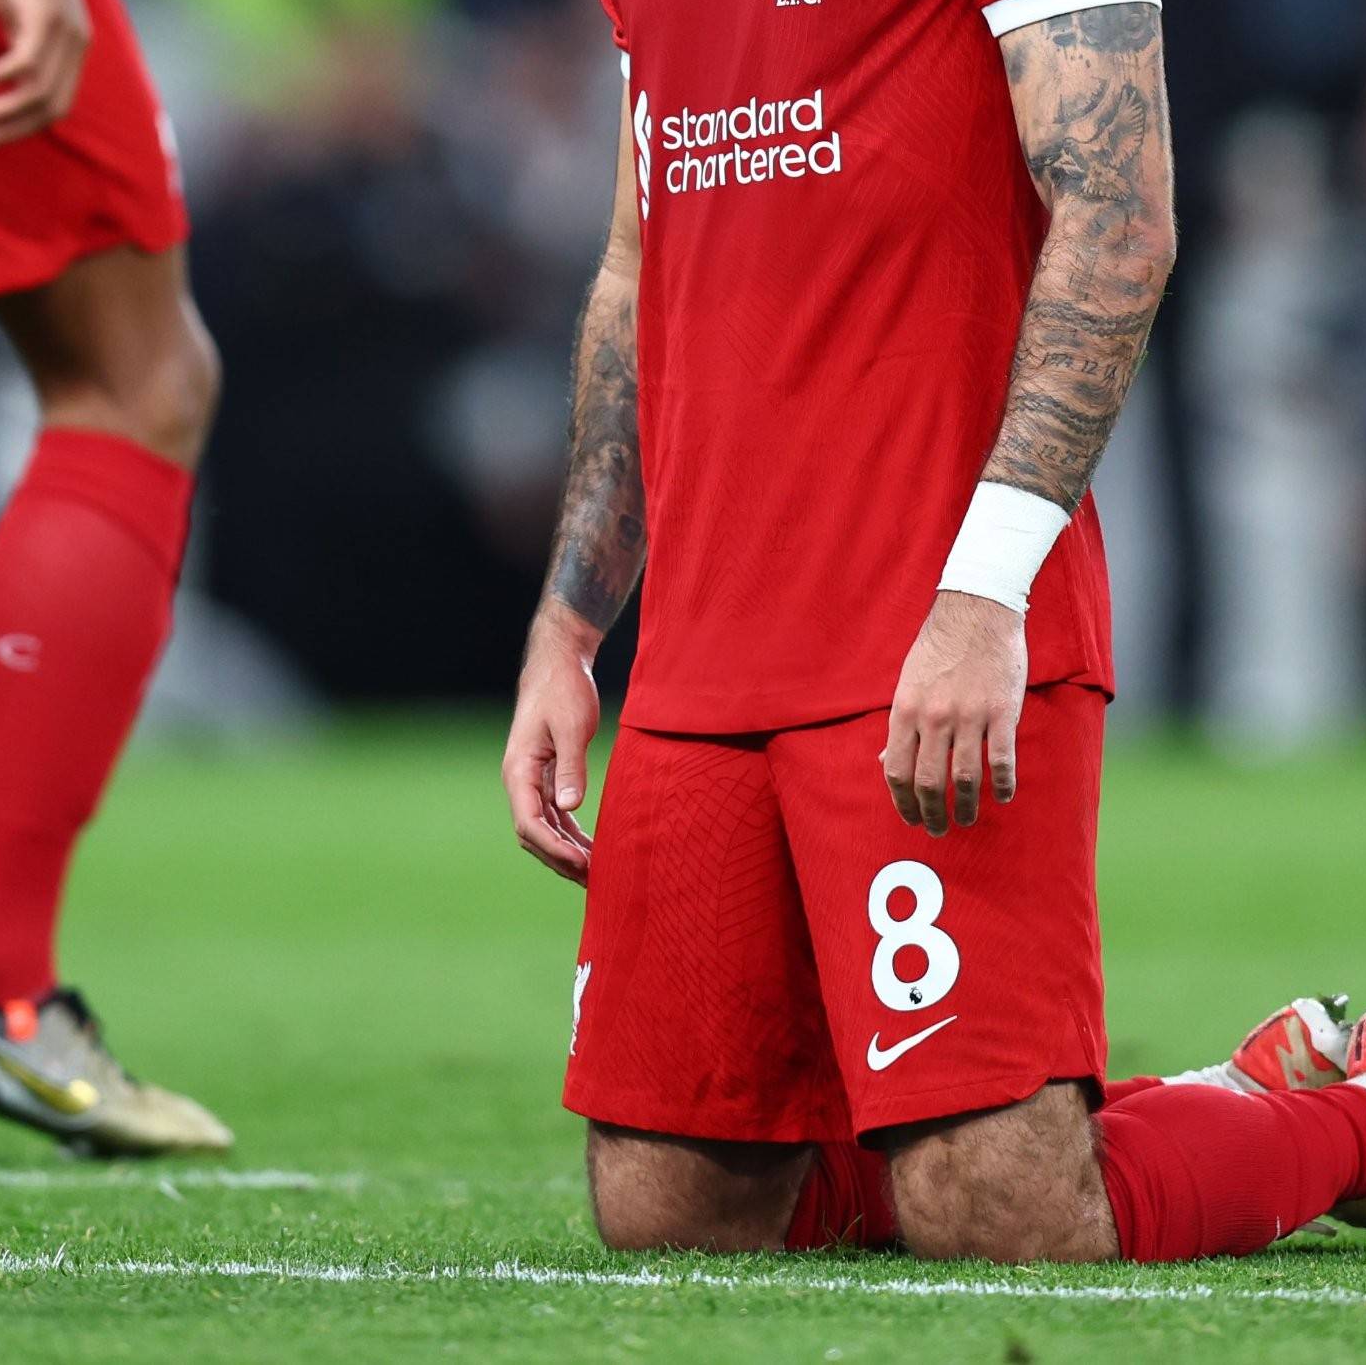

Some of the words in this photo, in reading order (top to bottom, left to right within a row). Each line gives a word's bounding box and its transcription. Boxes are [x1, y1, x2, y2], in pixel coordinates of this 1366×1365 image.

[661, 88, 823, 151] standard
[665, 131, 841, 194] chartered
[867, 859, 961, 1012] 8
